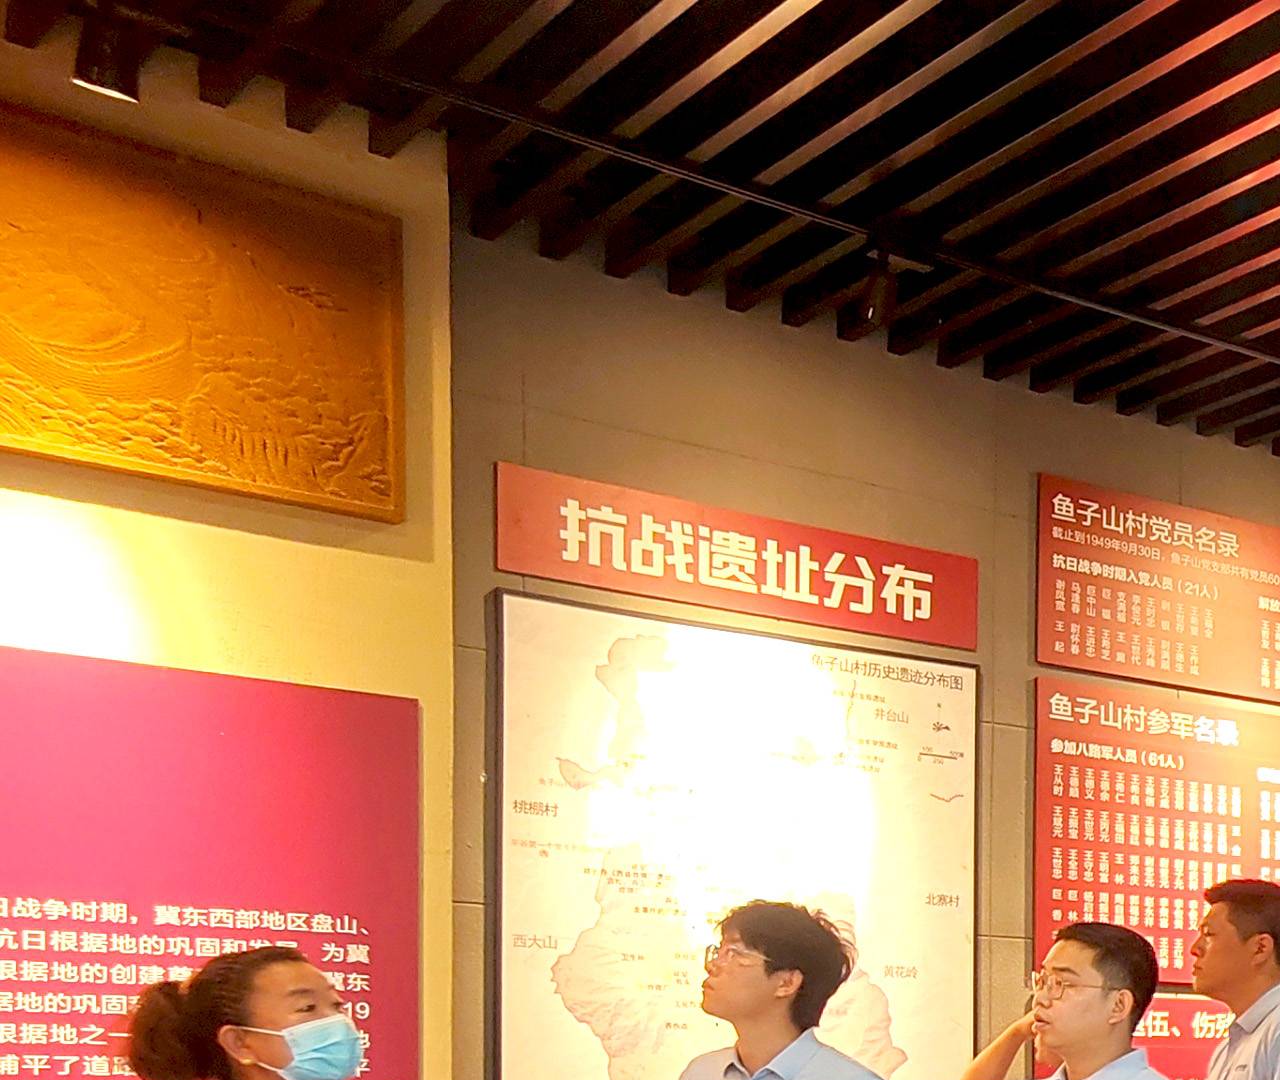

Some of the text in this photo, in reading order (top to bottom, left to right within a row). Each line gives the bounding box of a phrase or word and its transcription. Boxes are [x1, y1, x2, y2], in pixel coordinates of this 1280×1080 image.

[1051, 493, 1240, 558] 鱼子山村党员名录
[559, 498, 935, 622] 抗战遗址分布
[511, 934, 558, 950] 西大山
[342, 1002, 371, 1020] 19
